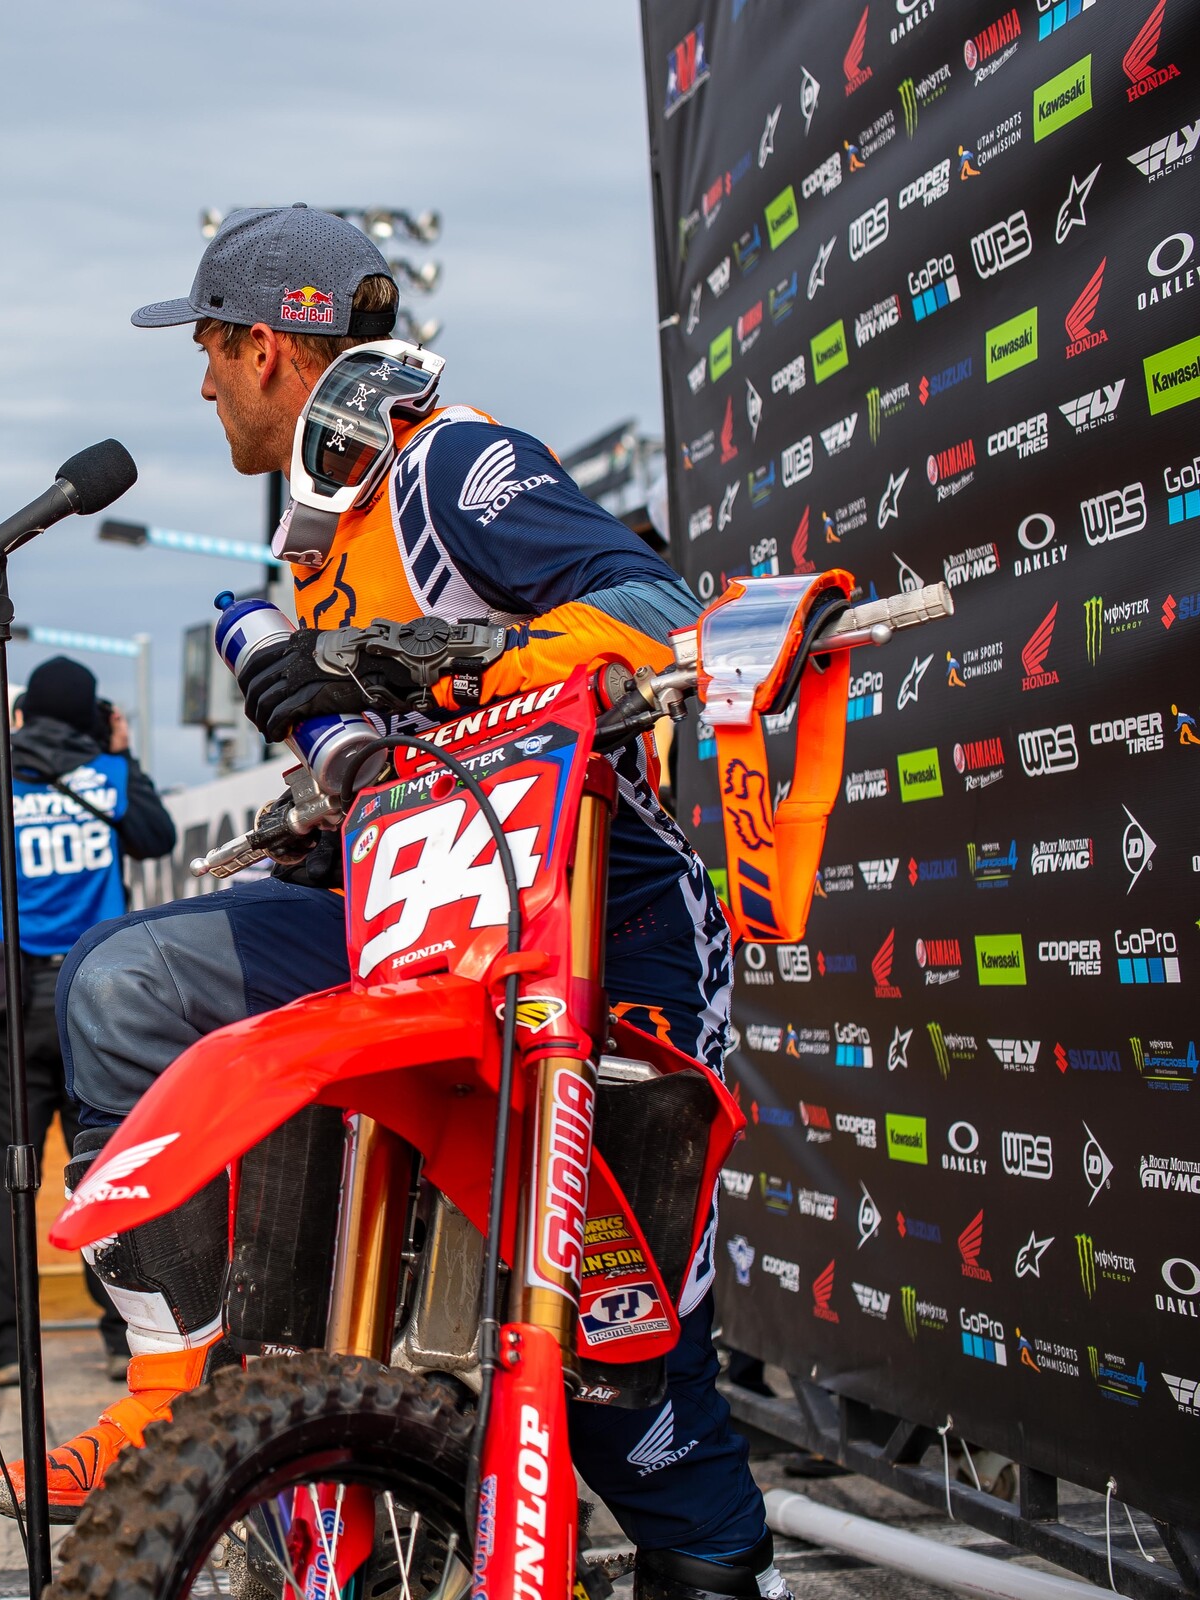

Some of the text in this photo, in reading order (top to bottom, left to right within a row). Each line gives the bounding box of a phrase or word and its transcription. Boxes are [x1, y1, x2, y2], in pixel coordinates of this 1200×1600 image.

[974, 8, 1021, 62] YAMAHA
[844, 67, 873, 96] HONDA
[1126, 63, 1181, 103] HONDA
[1038, 75, 1086, 122] Kawasaki
[977, 112, 1022, 151] UTAH SPORTS
[977, 128, 1022, 167] COMMISSION
[802, 152, 841, 199] COOPER
[1148, 155, 1192, 184] RACING
[899, 158, 950, 210] COOPER
[923, 178, 950, 208] TIRES
[971, 209, 1033, 280] WPS
[908, 253, 955, 296] GoPro
[281, 305, 333, 323] Red Bull
[990, 326, 1033, 364] Kawasaki
[1065, 329, 1109, 360] HONDA
[930, 357, 972, 397] SUZUKI
[987, 412, 1048, 457] COOPER
[1075, 413, 1115, 435] RACING
[936, 439, 976, 480] YAMAHA
[1017, 433, 1048, 460] TIRES
[476, 473, 558, 527] HONDA
[1080, 481, 1148, 546] WPS
[1014, 544, 1068, 578] OAKLEY
[1104, 598, 1150, 625] MONSTER
[1110, 620, 1142, 635] ENERGY
[963, 641, 1003, 664] UTAH SPORTS
[963, 657, 1003, 680] COMMISSION
[1021, 671, 1060, 692] HONDA
[849, 671, 883, 699] GoPro
[1090, 712, 1163, 745] COOPER
[963, 737, 1005, 770] YAMAHA
[1018, 723, 1079, 777] WPS
[1126, 734, 1164, 755] TIRES
[903, 764, 937, 787] Kawasaki
[1039, 838, 1089, 854] ROCKY MOUNTAIN
[358, 774, 543, 979] 94
[919, 858, 957, 881] SUZUKI
[391, 939, 456, 969] HONDA
[925, 939, 962, 966] YAMAHA
[1038, 940, 1101, 961] COOPER
[1114, 928, 1176, 955] GoPro
[981, 951, 1020, 970] Kawasaki
[1068, 961, 1102, 976] TIRES
[875, 986, 902, 998] HONDA
[834, 1022, 870, 1045] GoPro
[1003, 1064, 1035, 1073] RACING
[1068, 1049, 1122, 1072] SUZUKI
[835, 1113, 876, 1133] COOPER
[942, 1154, 987, 1175] OAKLEY
[1001, 1131, 1053, 1180] WPS
[1149, 1154, 1169, 1170] ROCKY
[542, 1070, 596, 1290] SHOWA
[583, 1229, 629, 1244] NECTION
[961, 1263, 993, 1282] HONDA
[1095, 1250, 1136, 1273] MONSTER
[1102, 1271, 1131, 1283] ENERGY
[601, 1291, 640, 1322] TJ
[960, 1307, 1004, 1340] GoPro
[1034, 1338, 1078, 1361] UTAH SPORTS
[1036, 1354, 1079, 1377] COMMISSION
[637, 1439, 699, 1477] HONDA
